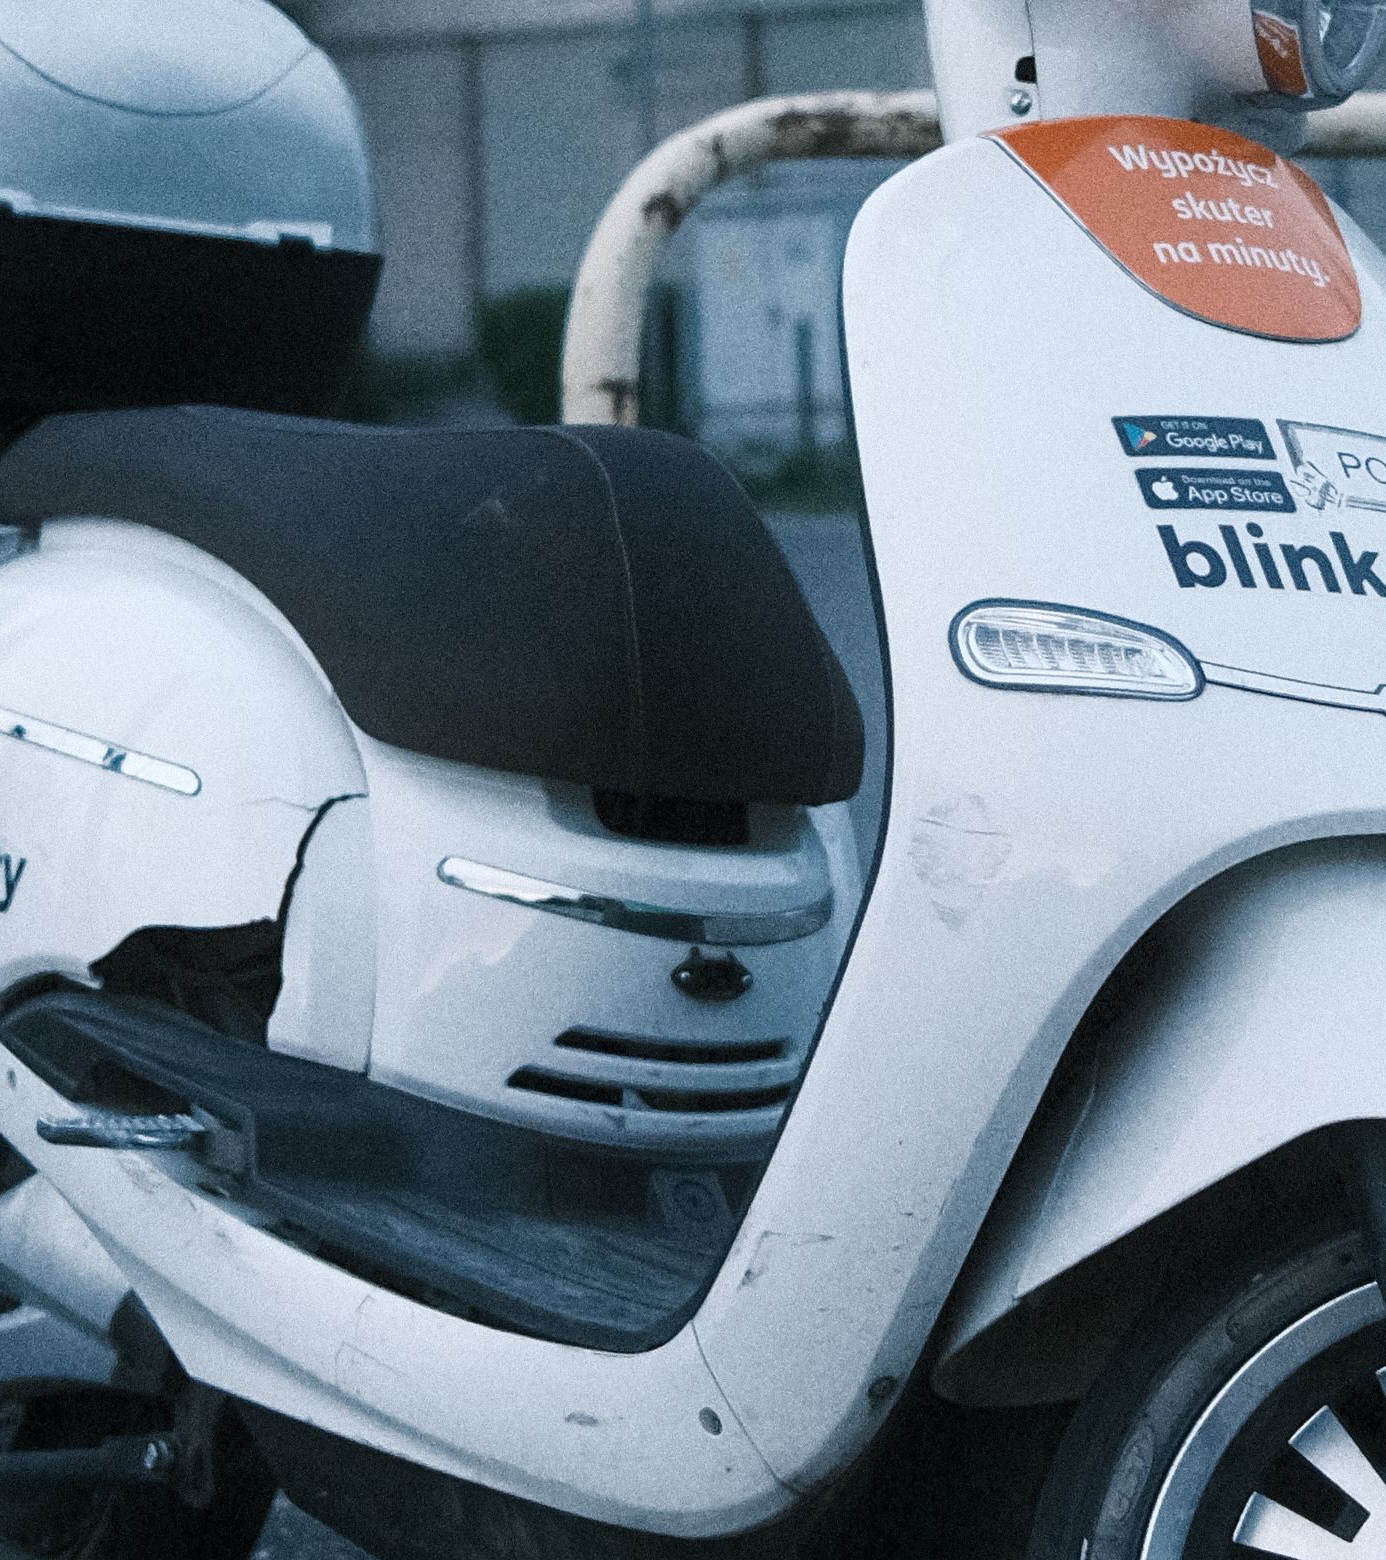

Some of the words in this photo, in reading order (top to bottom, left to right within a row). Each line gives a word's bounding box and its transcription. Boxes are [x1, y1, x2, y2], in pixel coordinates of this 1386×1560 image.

[1108, 143, 1279, 190] Wypożycz
[1171, 191, 1274, 228] skuter
[1153, 241, 1203, 264] na
[1206, 237, 1331, 288] minuty.
[1165, 432, 1228, 453] Google
[1228, 433, 1264, 455] Play
[1188, 485, 1229, 505] App
[1230, 485, 1285, 505] Store
